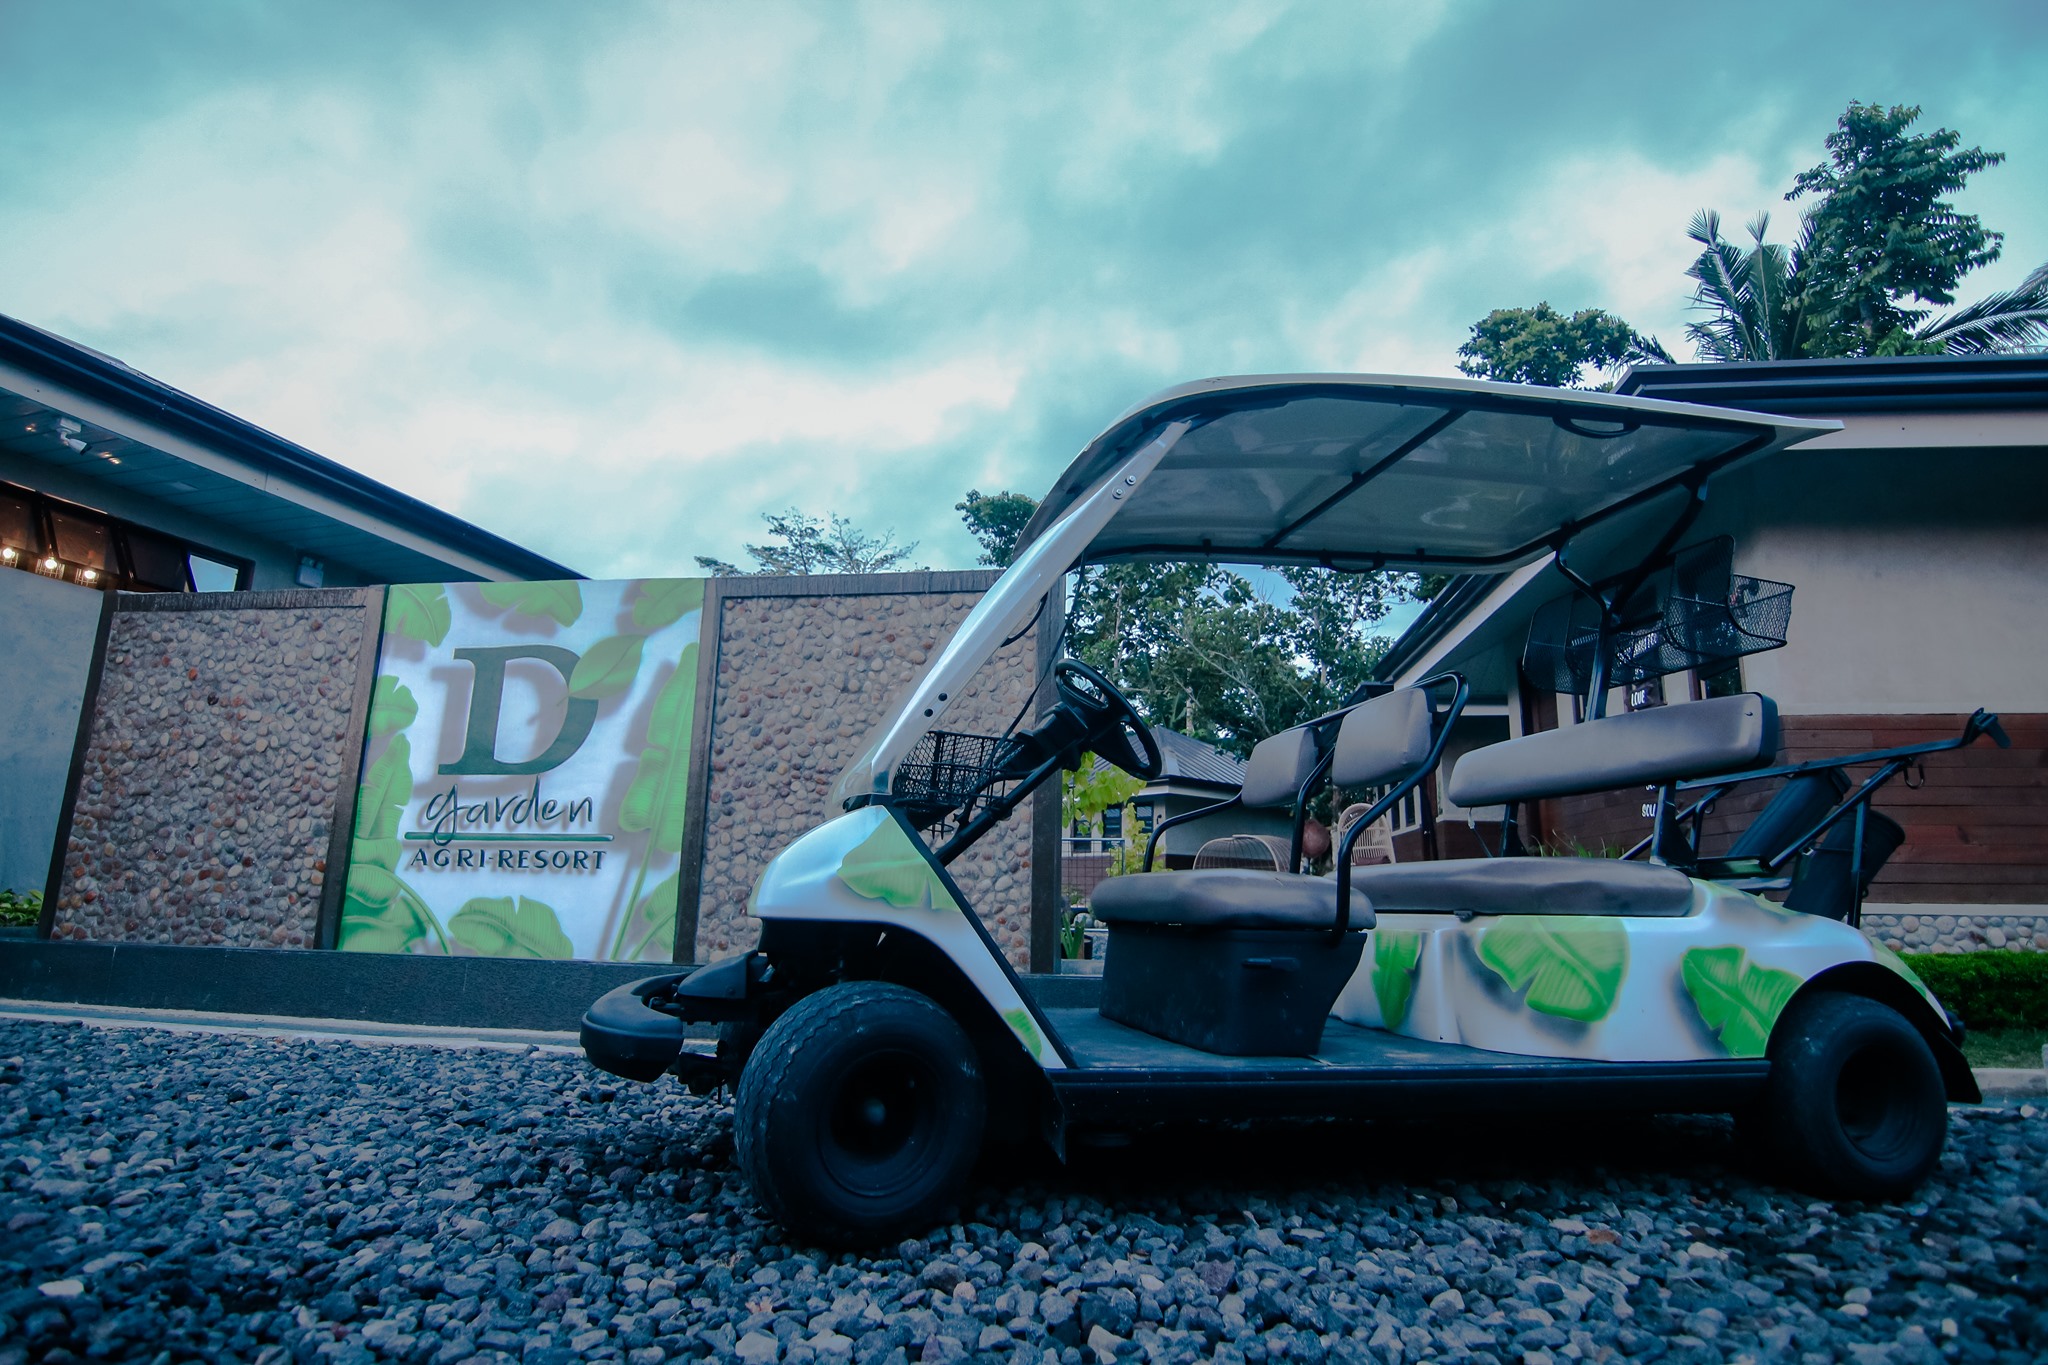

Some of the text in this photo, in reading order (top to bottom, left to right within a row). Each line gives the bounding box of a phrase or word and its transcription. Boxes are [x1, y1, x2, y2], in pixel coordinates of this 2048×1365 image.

[437, 644, 600, 777] D
[425, 774, 594, 847] garden
[410, 847, 608, 870] AGRI-RESORT
